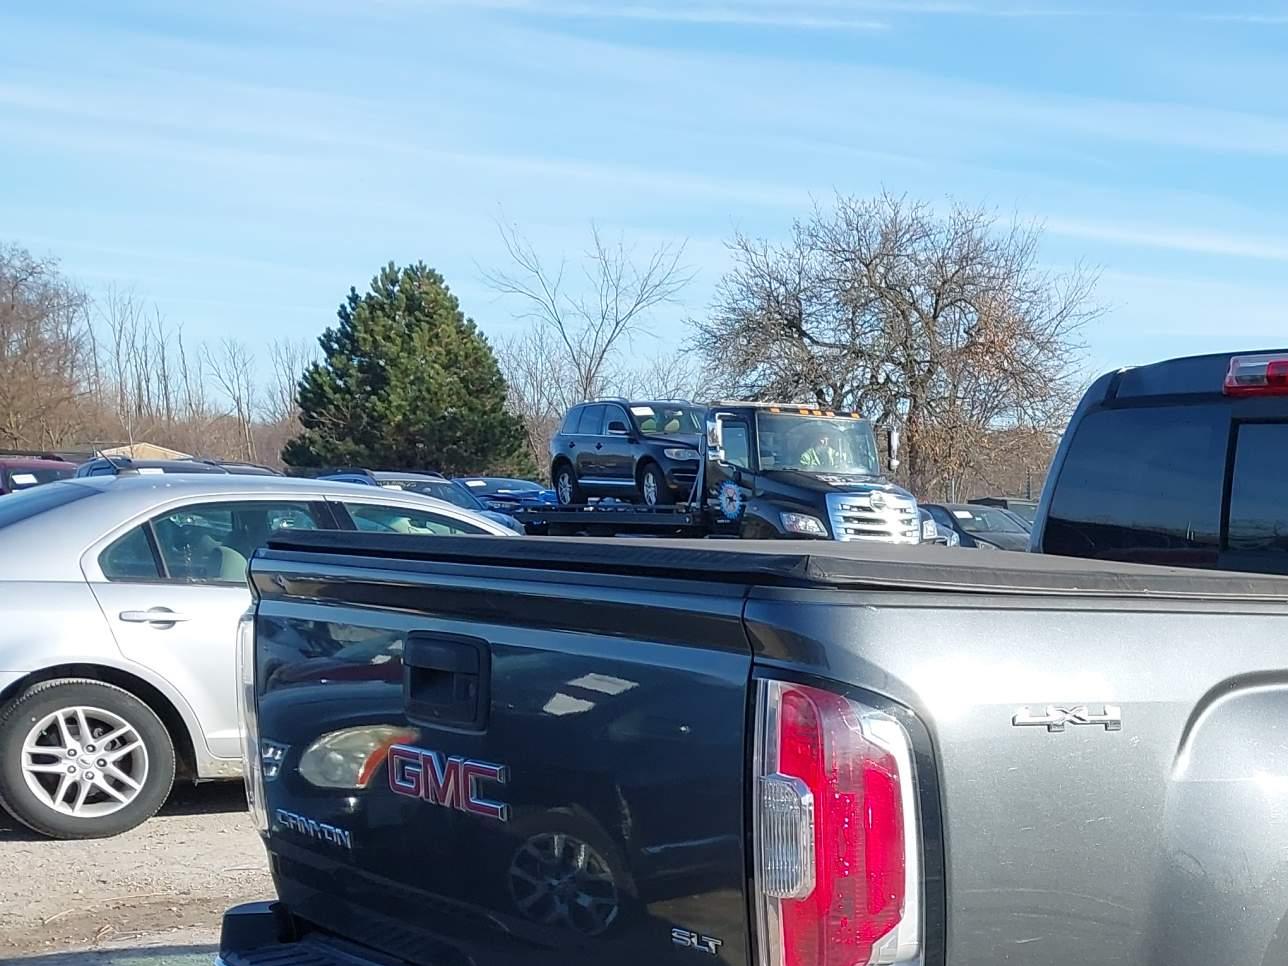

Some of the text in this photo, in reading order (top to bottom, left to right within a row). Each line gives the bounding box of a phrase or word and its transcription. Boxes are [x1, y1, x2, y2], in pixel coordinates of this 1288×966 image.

[387, 743, 510, 822] GMC
[276, 808, 352, 849] CANYON
[671, 927, 723, 955] SLT
